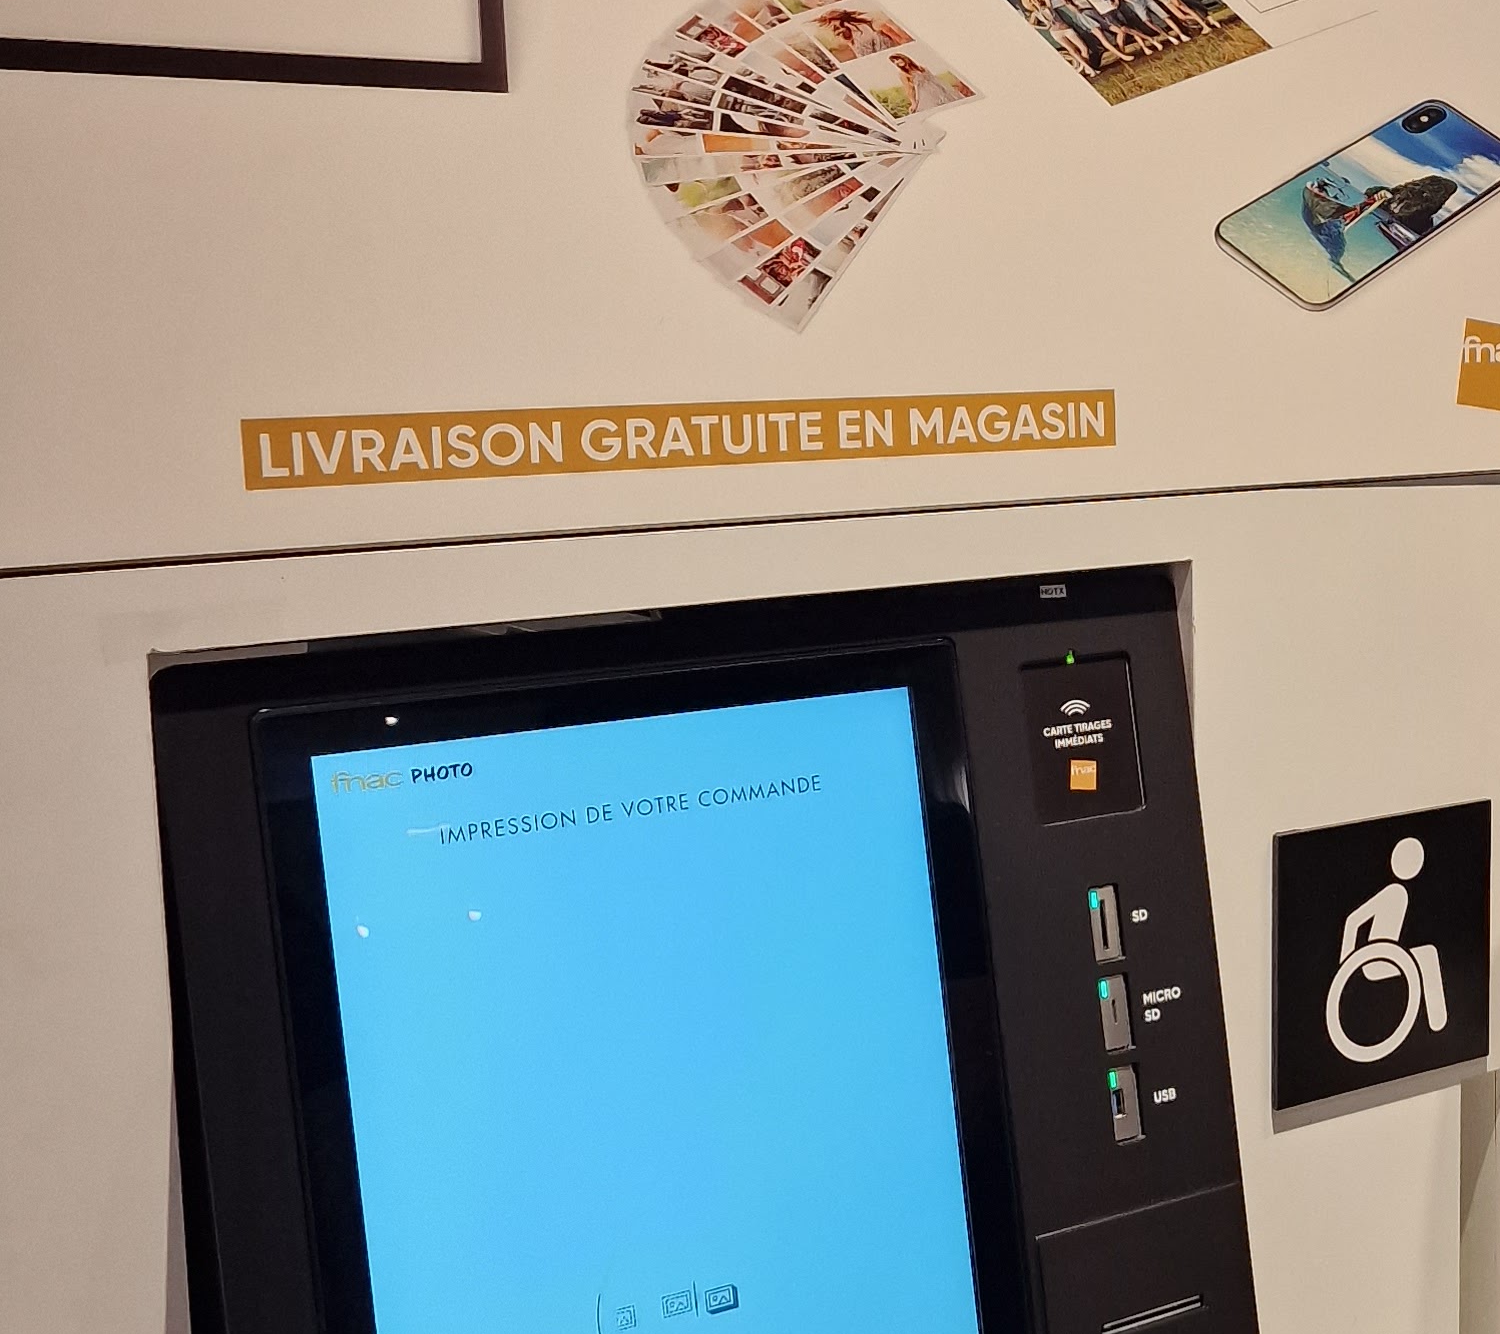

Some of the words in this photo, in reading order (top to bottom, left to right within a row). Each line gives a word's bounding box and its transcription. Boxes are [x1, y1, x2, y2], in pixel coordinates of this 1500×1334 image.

[259, 421, 564, 478] LIVRAISON
[579, 411, 824, 461] GRATUITE
[838, 409, 894, 449] EN
[909, 401, 1105, 446] MAGASIN
[1042, 723, 1073, 738] CARTE
[1074, 718, 1113, 734] TIRAGES
[1054, 732, 1104, 750] IMMÉDIATS
[330, 770, 403, 795] fnac
[411, 762, 473, 784] PHOTO
[439, 810, 577, 846] IMPRESSION
[586, 803, 614, 825] DE
[621, 792, 690, 819] VOTRE
[697, 774, 823, 809] COMMANDE
[1131, 909, 1148, 923] SD
[1142, 986, 1181, 1006] MICRO
[1144, 1008, 1161, 1023] SD
[1153, 1087, 1177, 1105] USB
